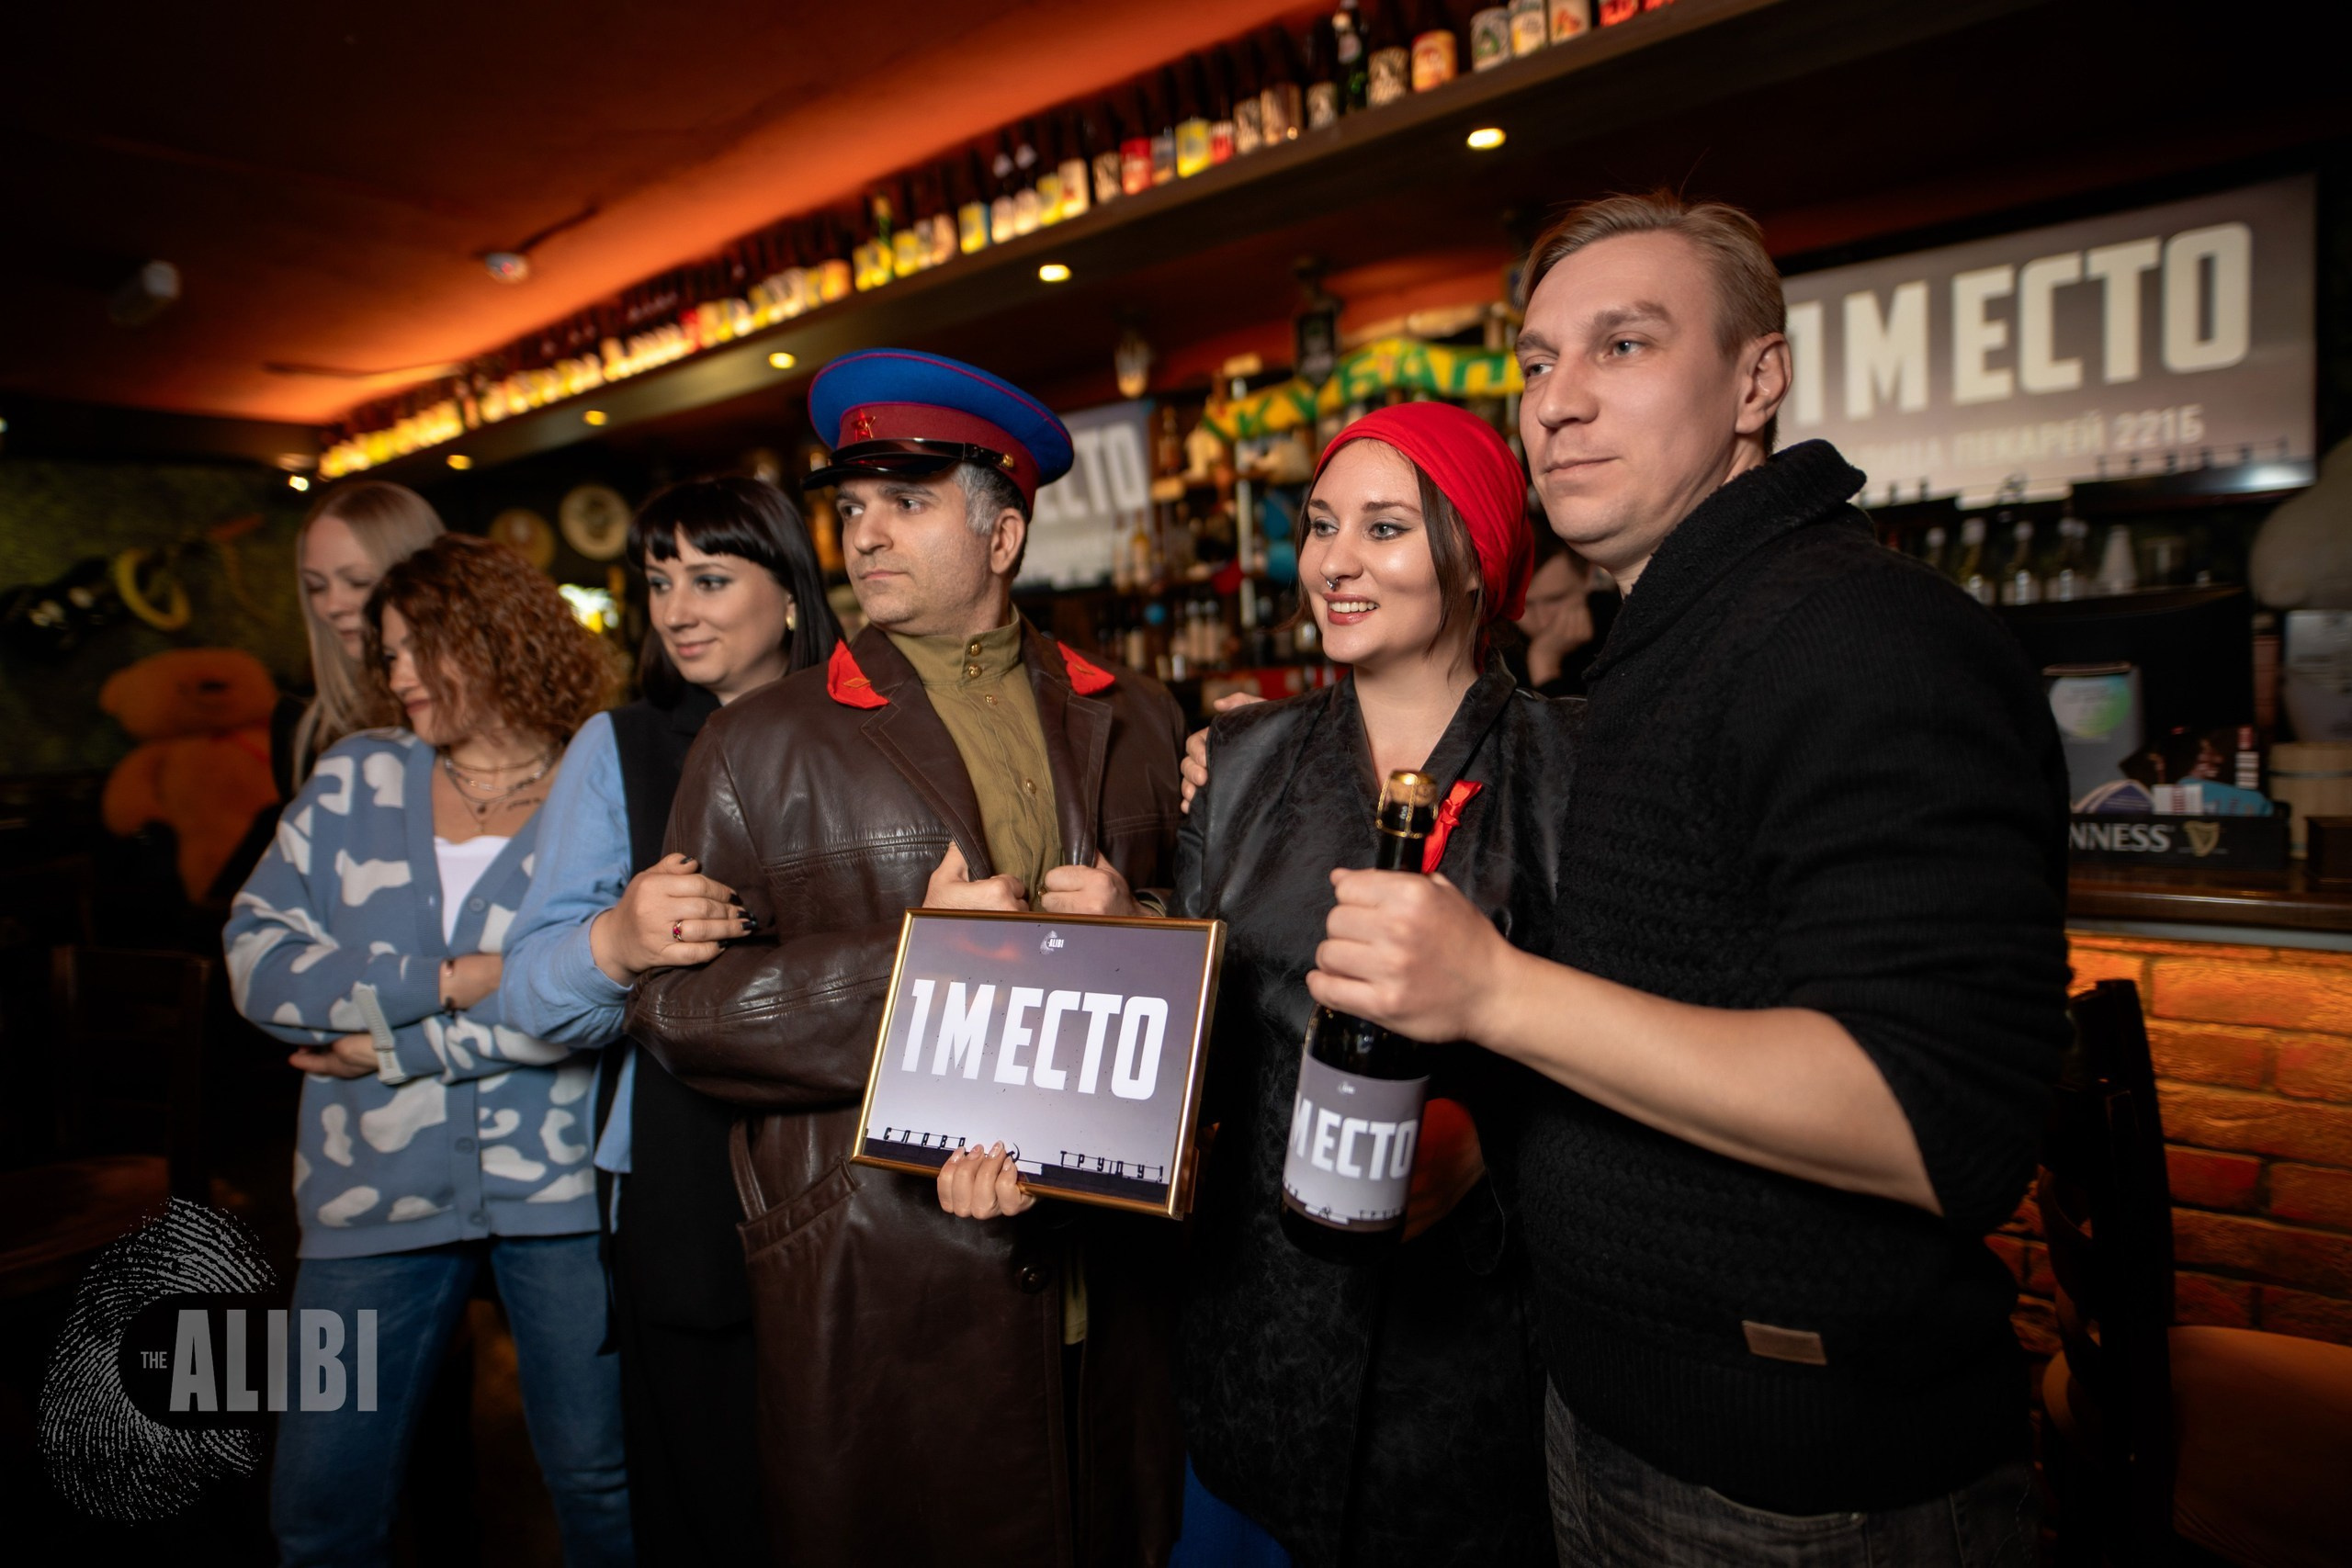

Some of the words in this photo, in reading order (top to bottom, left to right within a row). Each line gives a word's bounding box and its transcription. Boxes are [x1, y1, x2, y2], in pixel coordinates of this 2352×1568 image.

[1843, 221, 2253, 421] МЕСТО
[901, 978, 936, 1073] 1
[931, 980, 1169, 1101] МЕСТО
